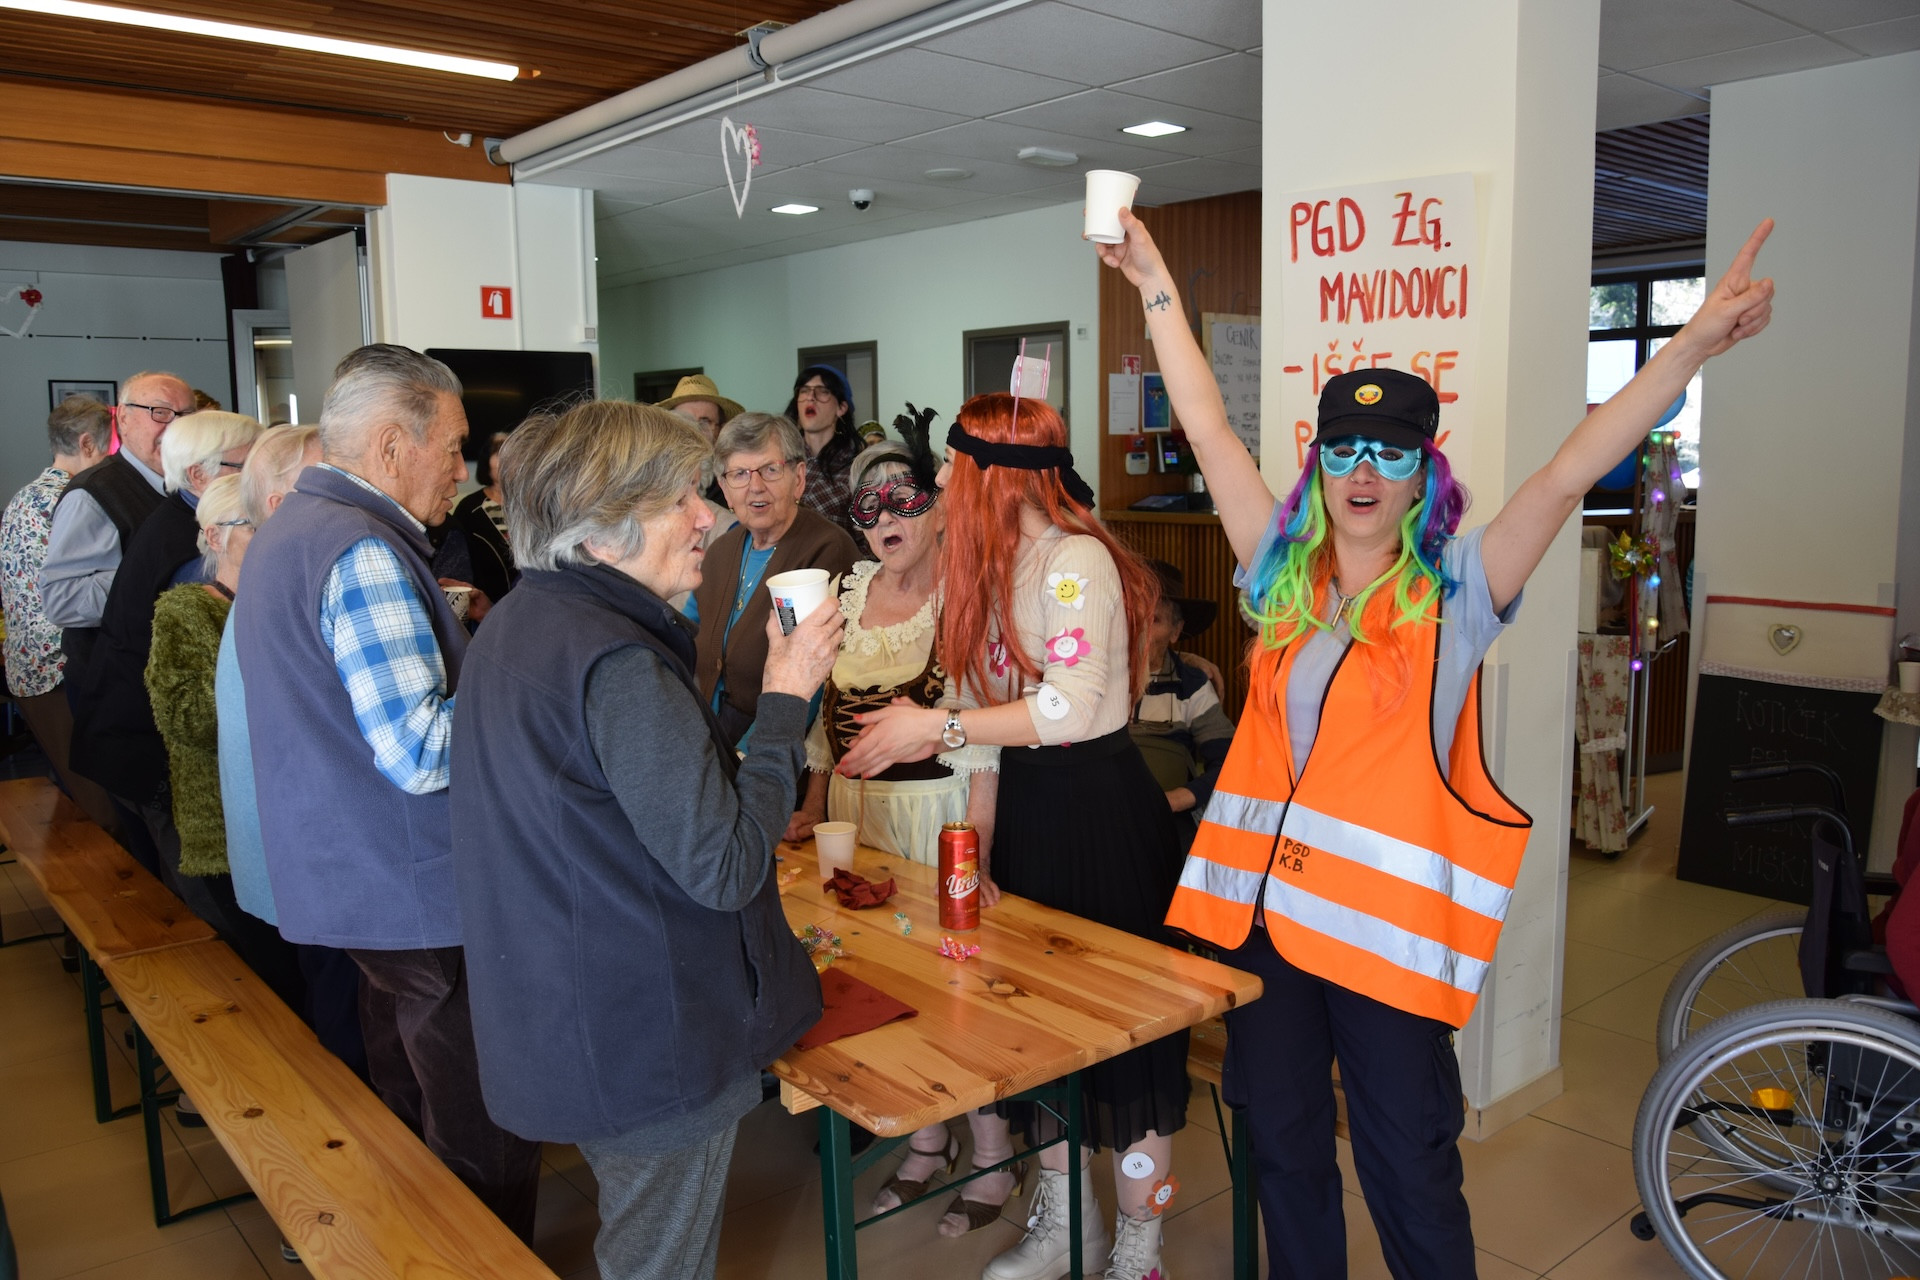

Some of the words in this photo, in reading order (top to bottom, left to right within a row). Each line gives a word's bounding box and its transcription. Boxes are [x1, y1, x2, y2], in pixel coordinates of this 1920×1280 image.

[1290, 197, 1366, 263] PGD
[1320, 264, 1468, 324] MAVIDOVCI
[1226, 326, 1258, 350] CENIK
[1411, 350, 1459, 404] SE
[1283, 837, 1310, 858] PGD
[1133, 1161, 1143, 1170] 18
